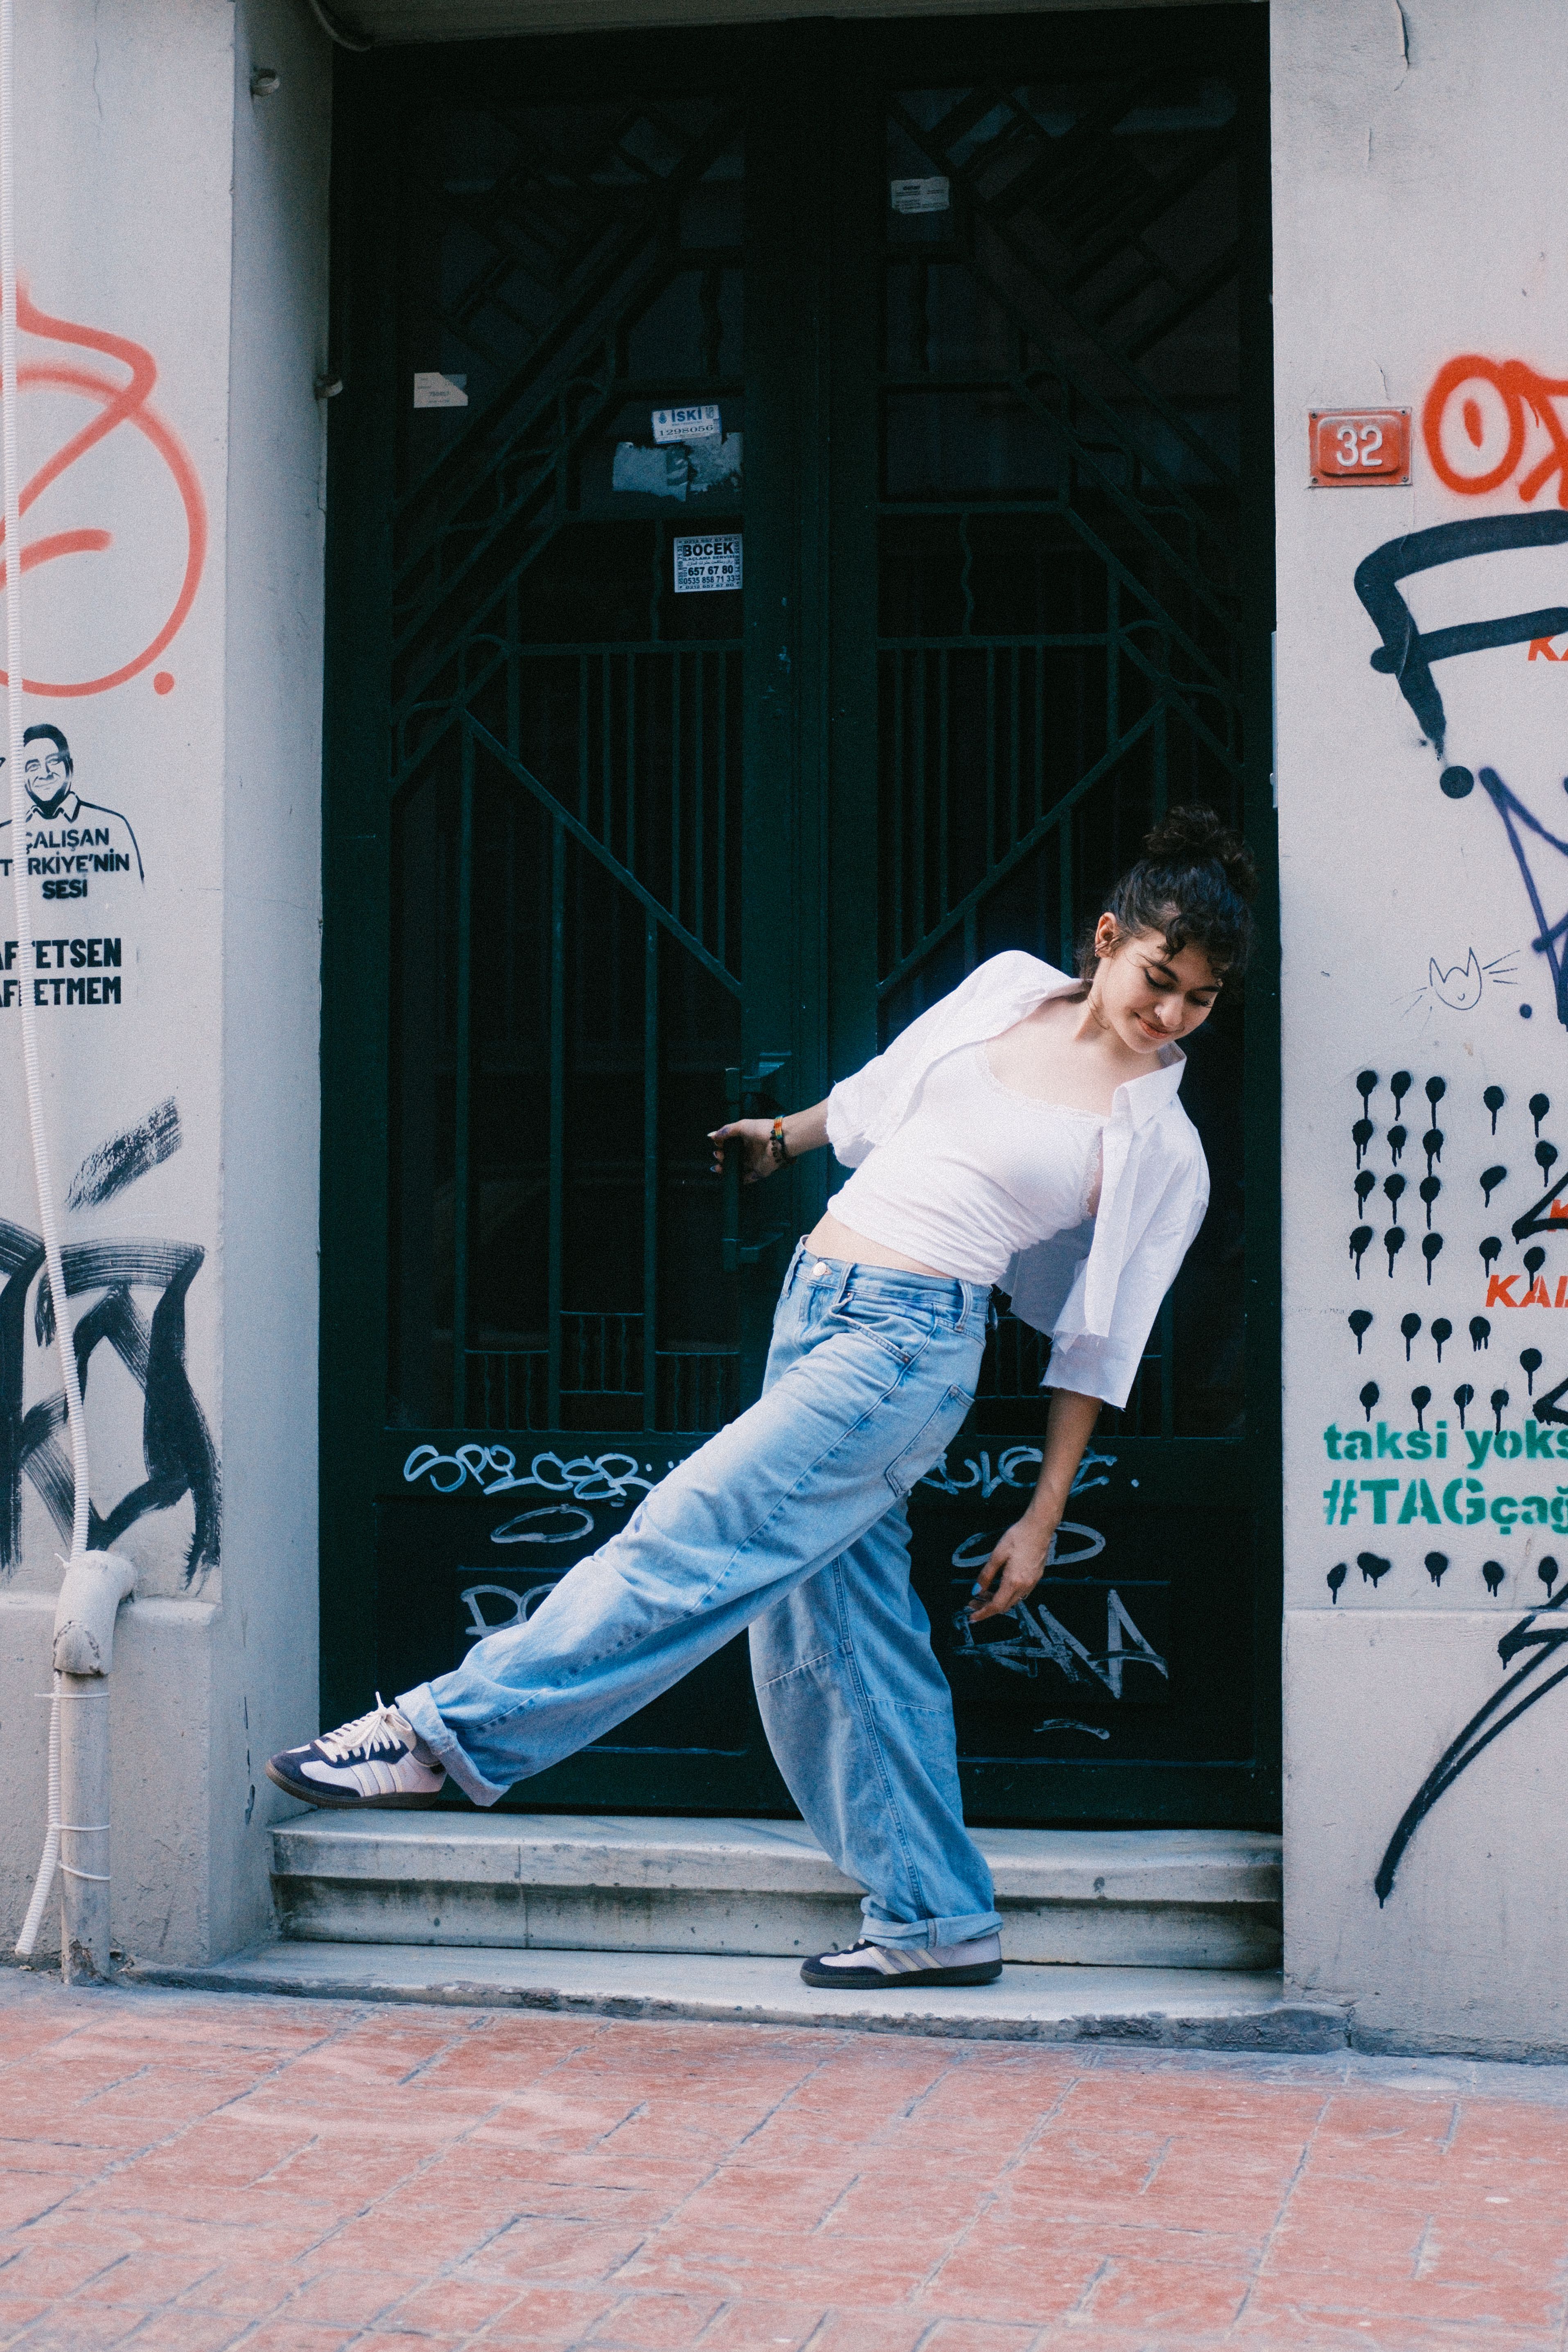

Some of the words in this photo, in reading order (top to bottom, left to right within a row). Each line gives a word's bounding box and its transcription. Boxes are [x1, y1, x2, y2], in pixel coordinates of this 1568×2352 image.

[659, 425, 714, 436] 1298056
[1336, 425, 1383, 467] 32
[688, 566, 705, 576] 657
[708, 566, 719, 575] 67
[722, 565, 733, 574] 80
[0, 848, 130, 876] TRKİYE'NİN
[1323, 1420, 1448, 1460] taksi
